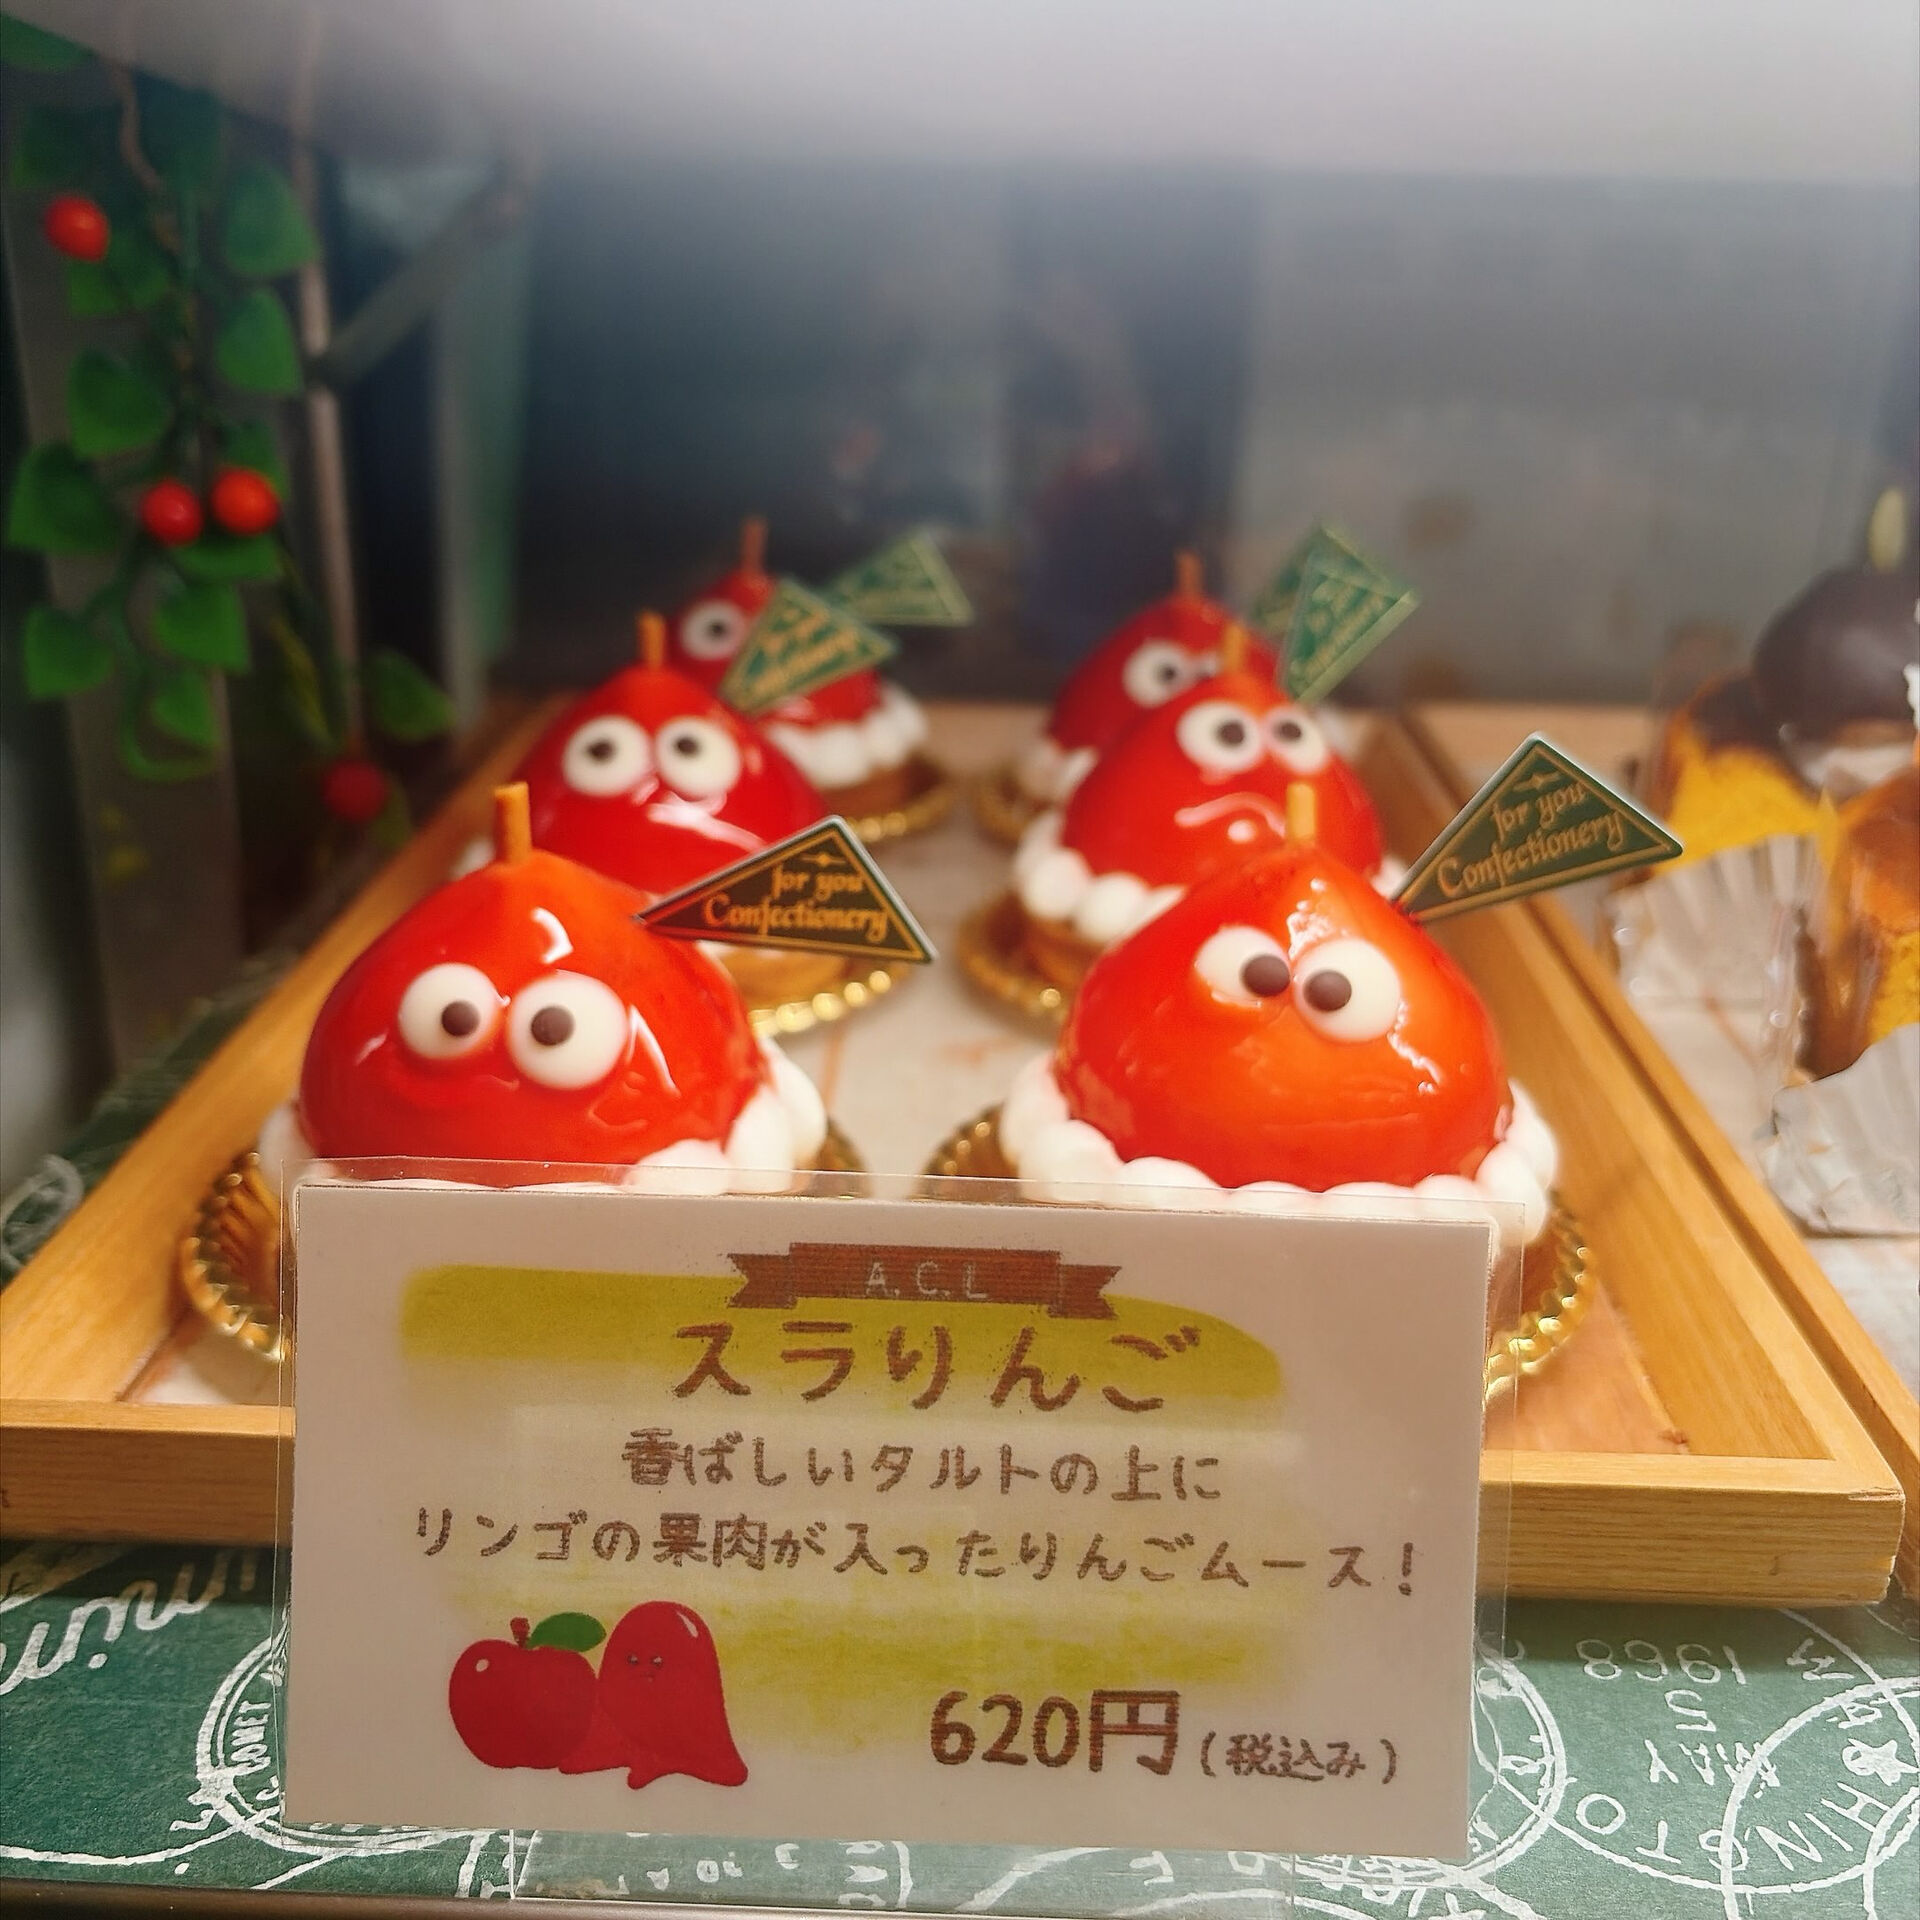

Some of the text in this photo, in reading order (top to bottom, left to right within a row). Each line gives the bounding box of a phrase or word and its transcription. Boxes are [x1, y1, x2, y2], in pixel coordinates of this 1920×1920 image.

[1536, 780, 1588, 829] you
[1437, 809, 1626, 898] Confectionery
[703, 891, 888, 944] Confectionery
[814, 872, 865, 901] you
[673, 1319, 1201, 1412] スラりんご
[622, 1427, 1221, 1501] 香ばしいタルトの上に
[1576, 1638, 1748, 1685] 1968
[930, 1689, 1181, 1776] 620円
